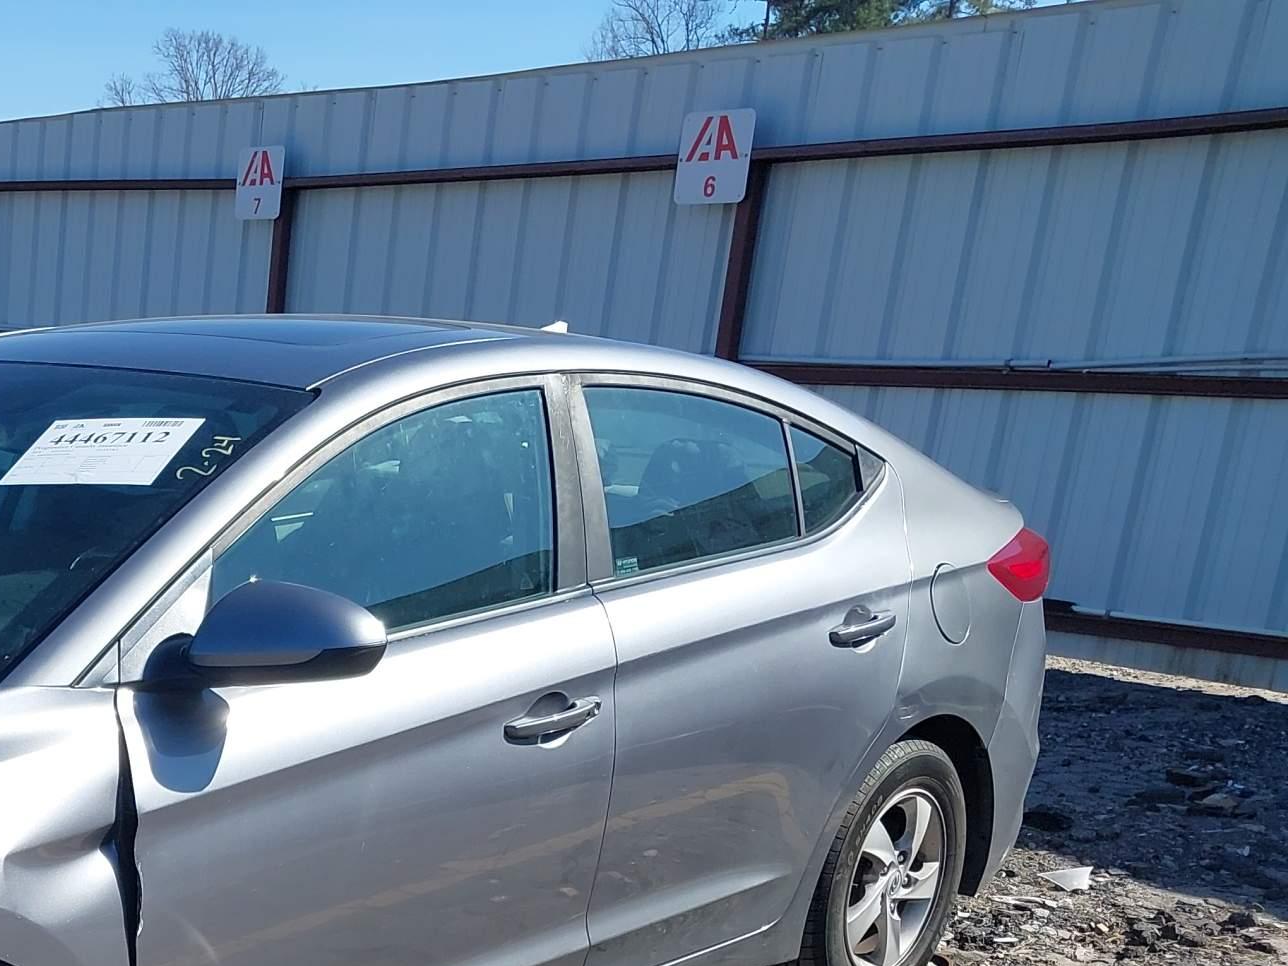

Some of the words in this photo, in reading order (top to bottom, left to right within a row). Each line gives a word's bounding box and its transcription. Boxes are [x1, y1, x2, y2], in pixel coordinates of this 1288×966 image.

[703, 175, 717, 198] 6
[253, 197, 262, 215] 7
[49, 431, 171, 446] 44467112
